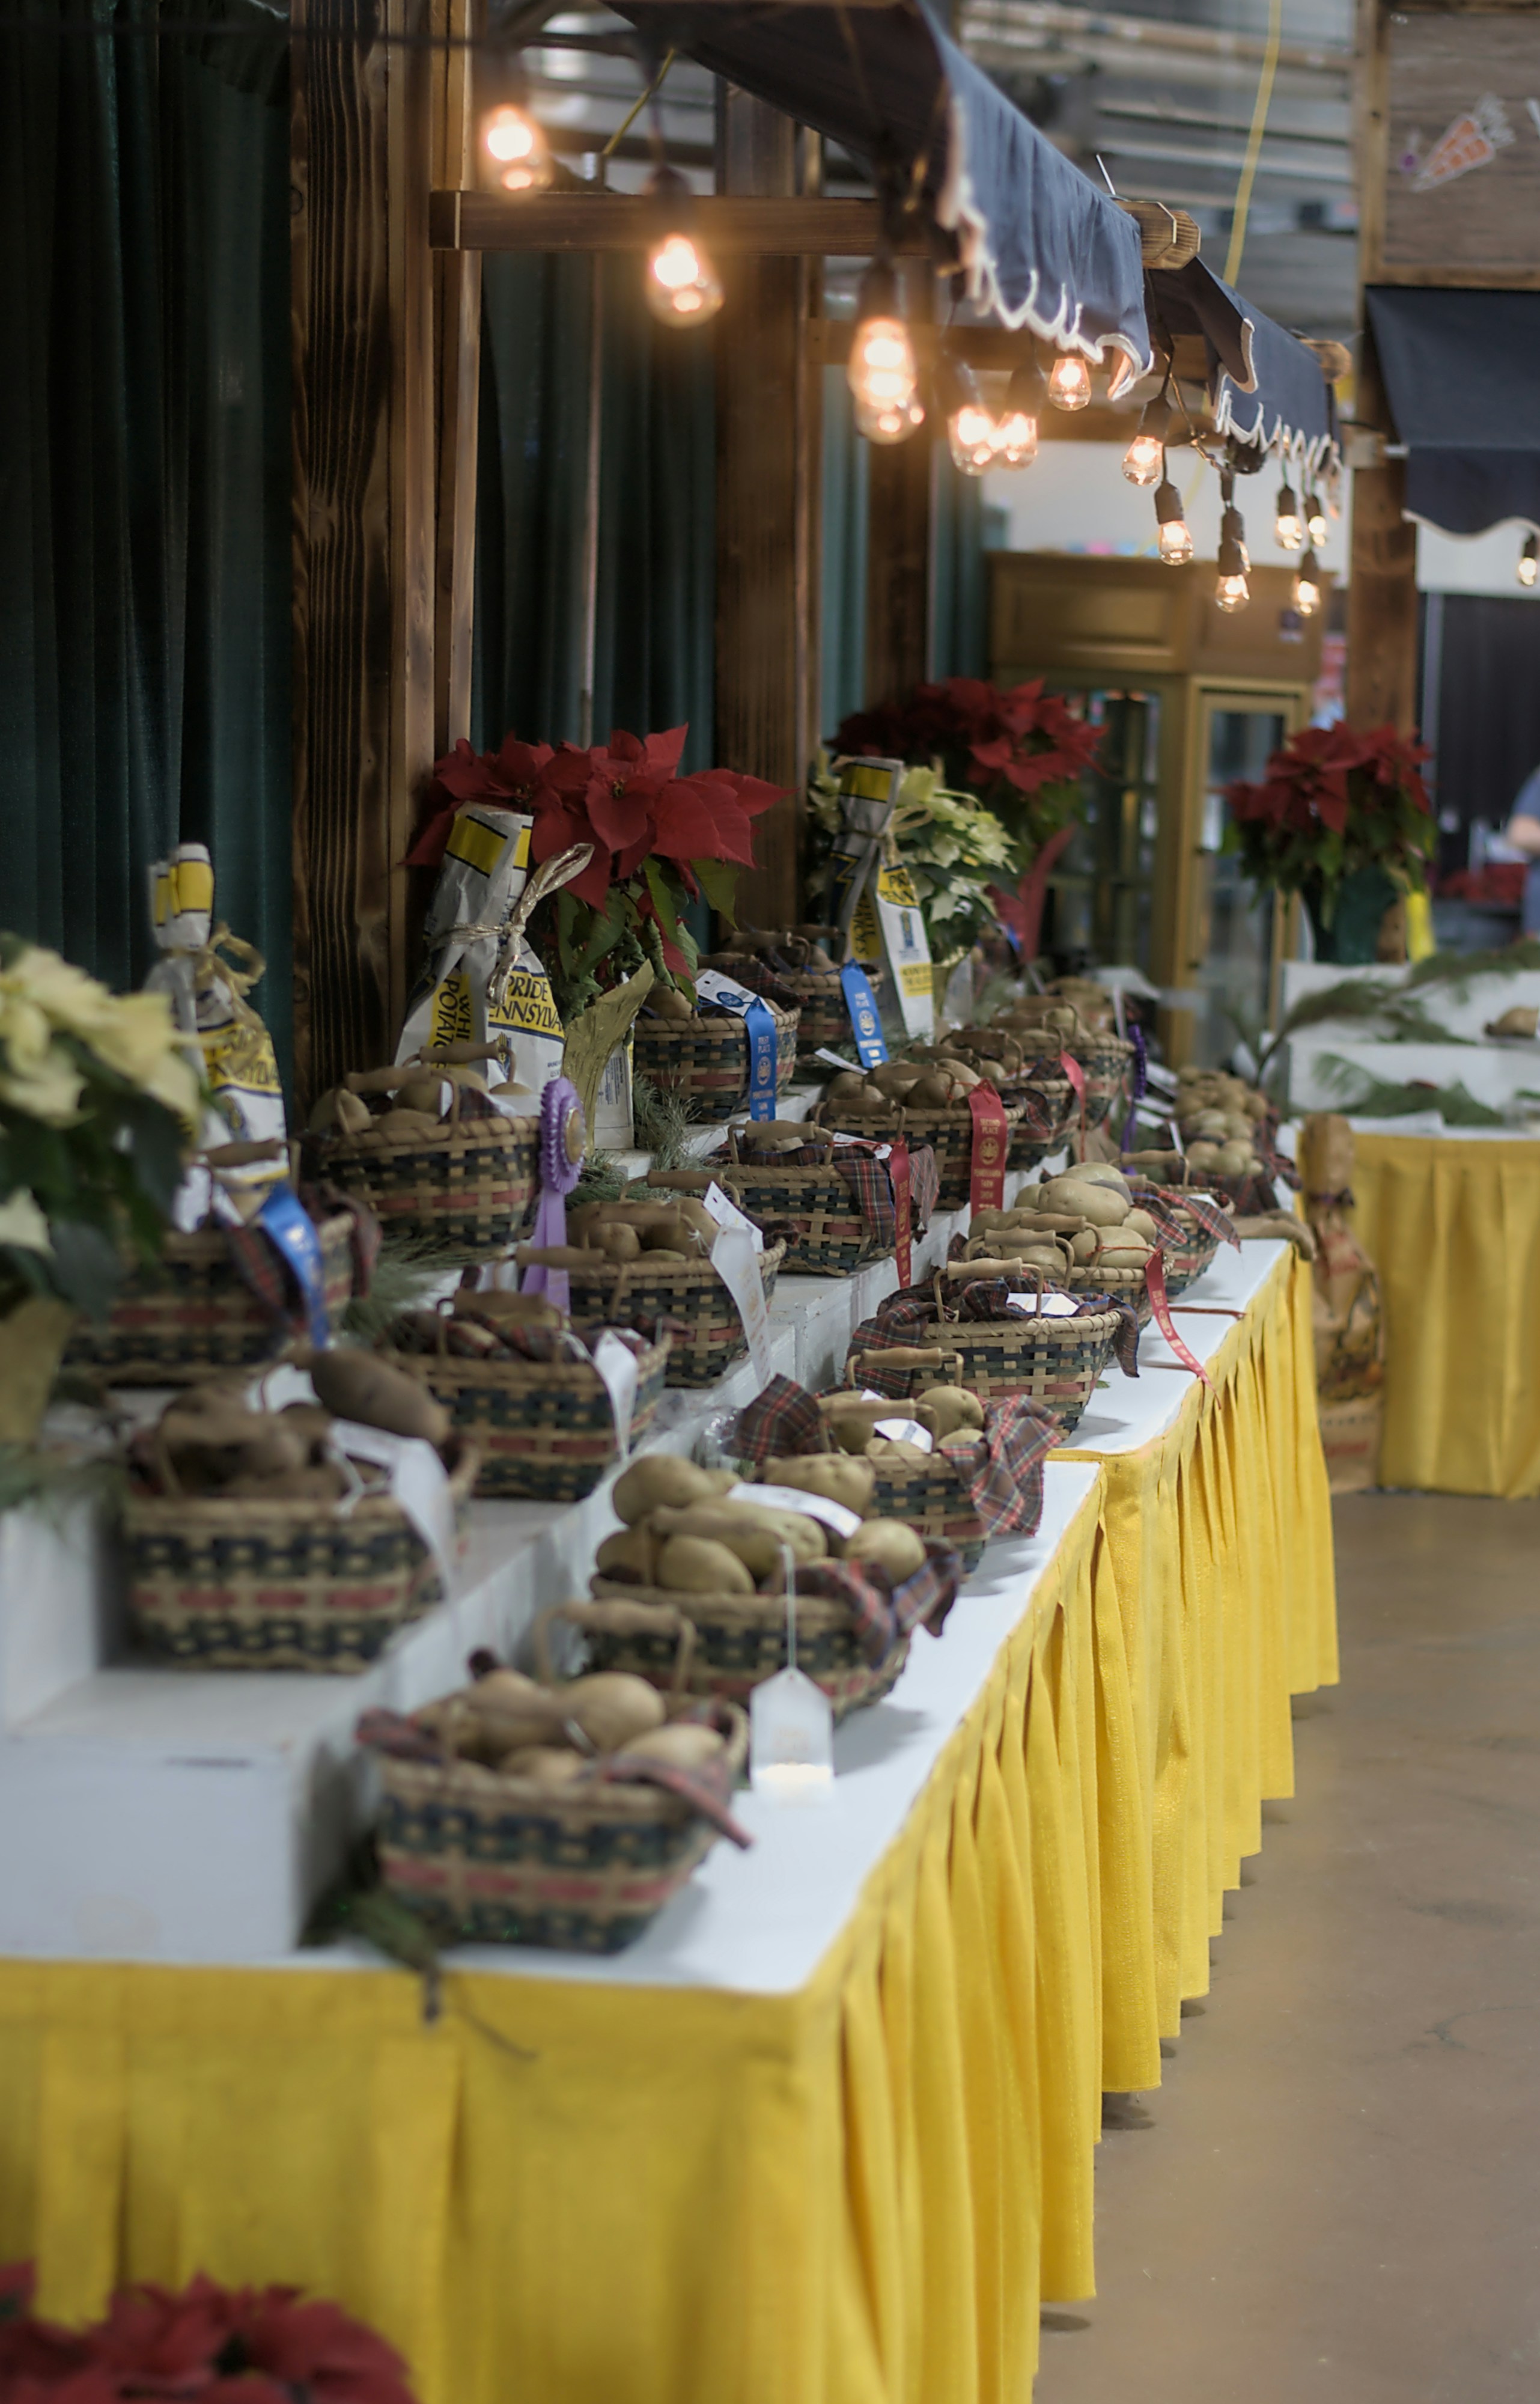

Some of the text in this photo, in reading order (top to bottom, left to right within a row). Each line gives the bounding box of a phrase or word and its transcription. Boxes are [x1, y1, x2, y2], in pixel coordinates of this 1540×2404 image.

[456, 994, 471, 1043] WHI
[488, 1001, 562, 1032] ENNSYLVA
[982, 1126, 999, 1135] PLACE
